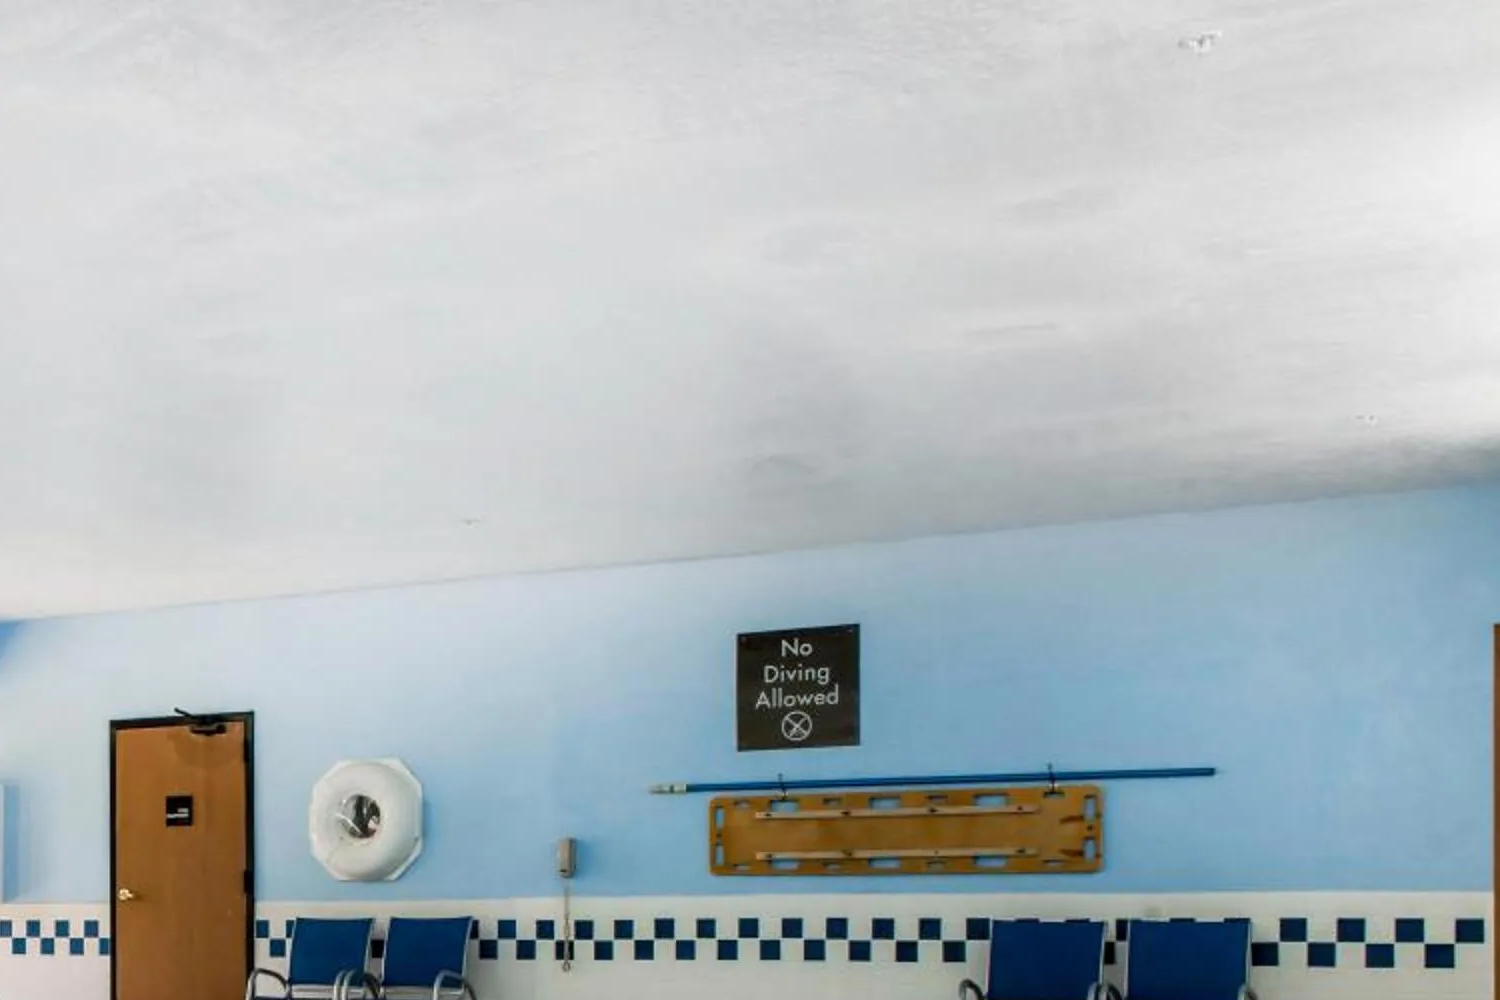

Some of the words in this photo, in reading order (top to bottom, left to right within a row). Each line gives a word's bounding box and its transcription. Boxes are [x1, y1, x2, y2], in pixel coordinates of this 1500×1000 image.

[781, 638, 813, 657] No
[763, 664, 830, 685] Diving
[755, 682, 839, 710] Allowed
